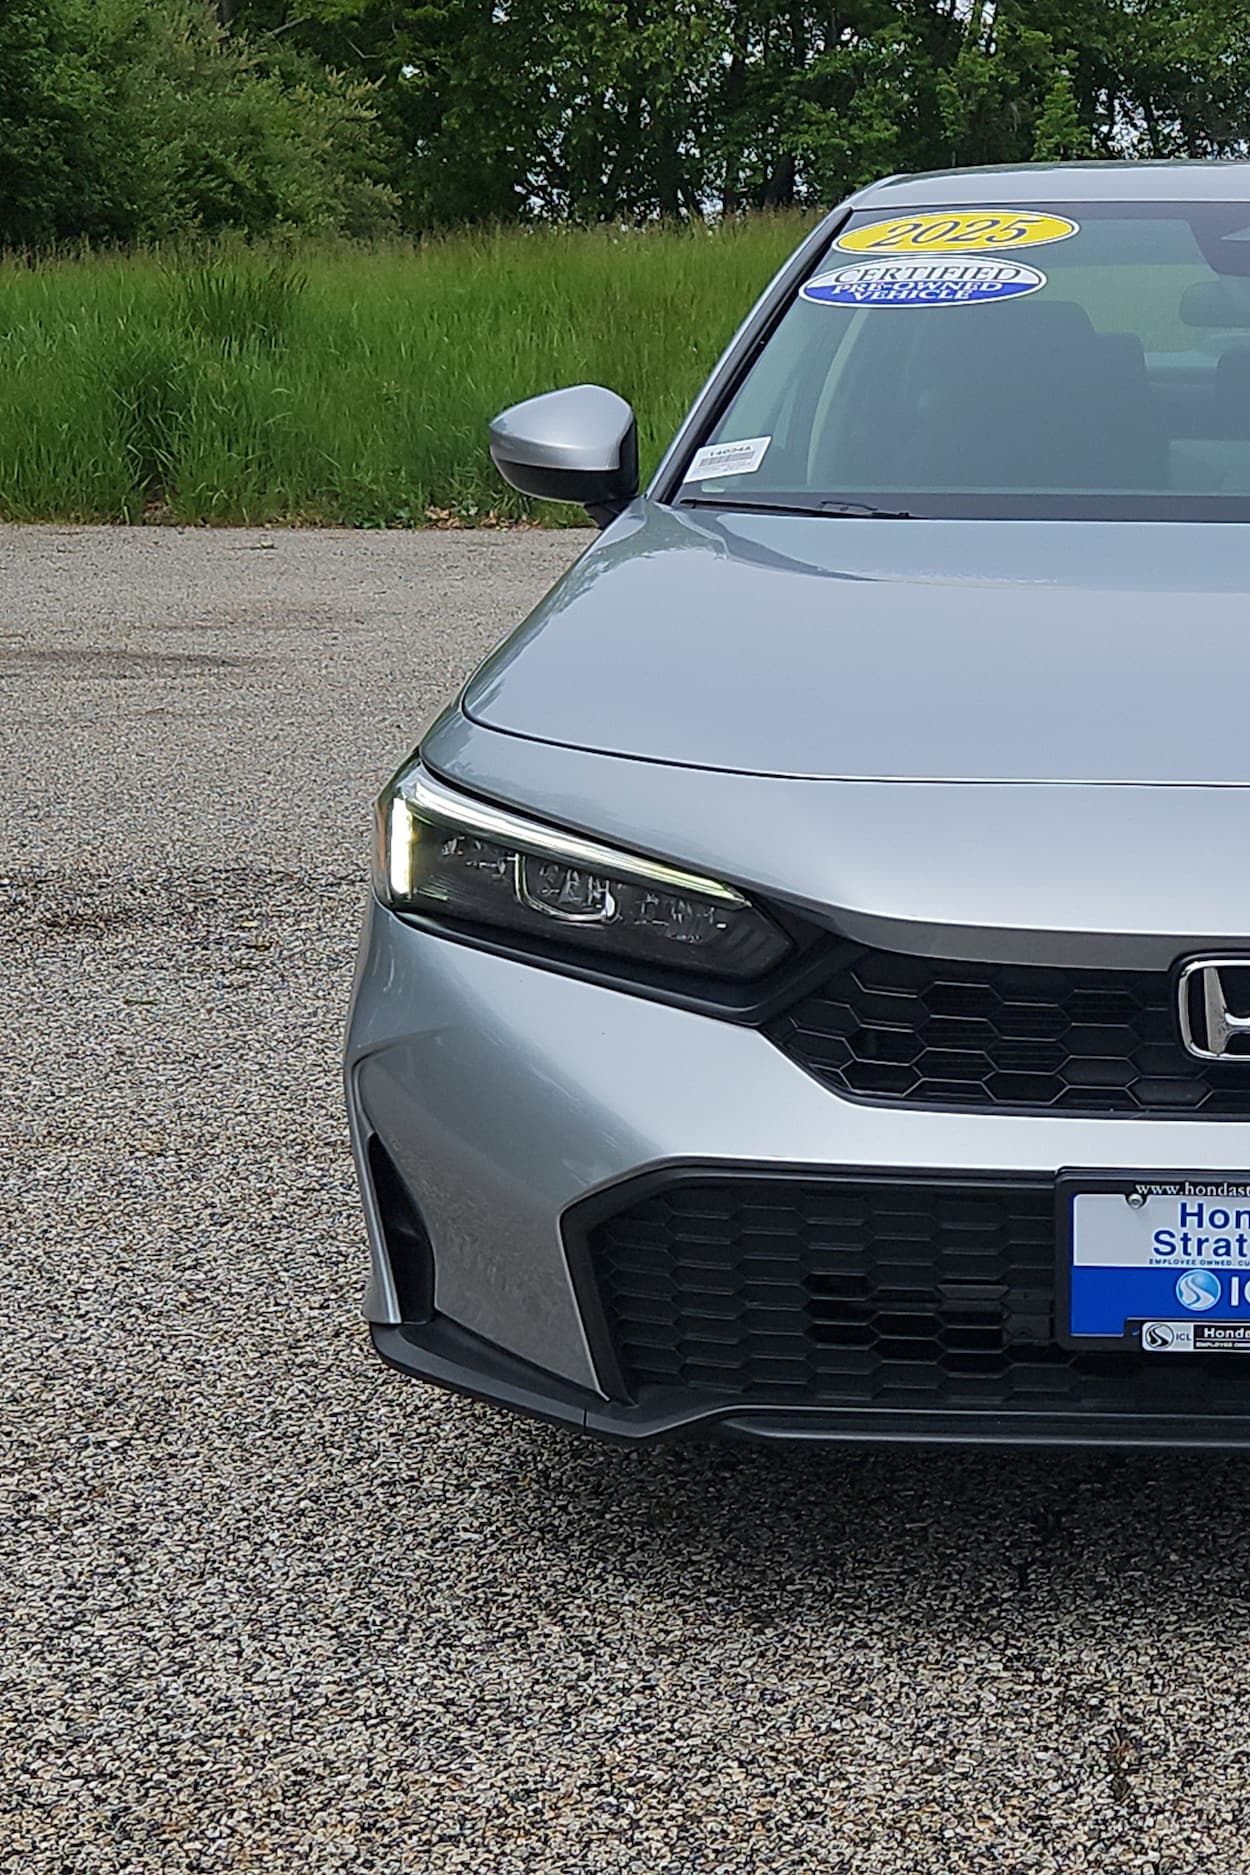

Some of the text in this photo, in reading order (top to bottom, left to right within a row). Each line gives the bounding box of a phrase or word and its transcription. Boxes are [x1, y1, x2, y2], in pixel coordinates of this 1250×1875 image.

[866, 218, 1043, 248] 2025
[834, 266, 1022, 284] CERTIFIED
[832, 280, 1003, 295] PRE-OWNED
[854, 289, 972, 301] VEHICLE
[1149, 1258, 1196, 1266] EMPLOYEE
[1176, 1333, 1192, 1341] ICL
